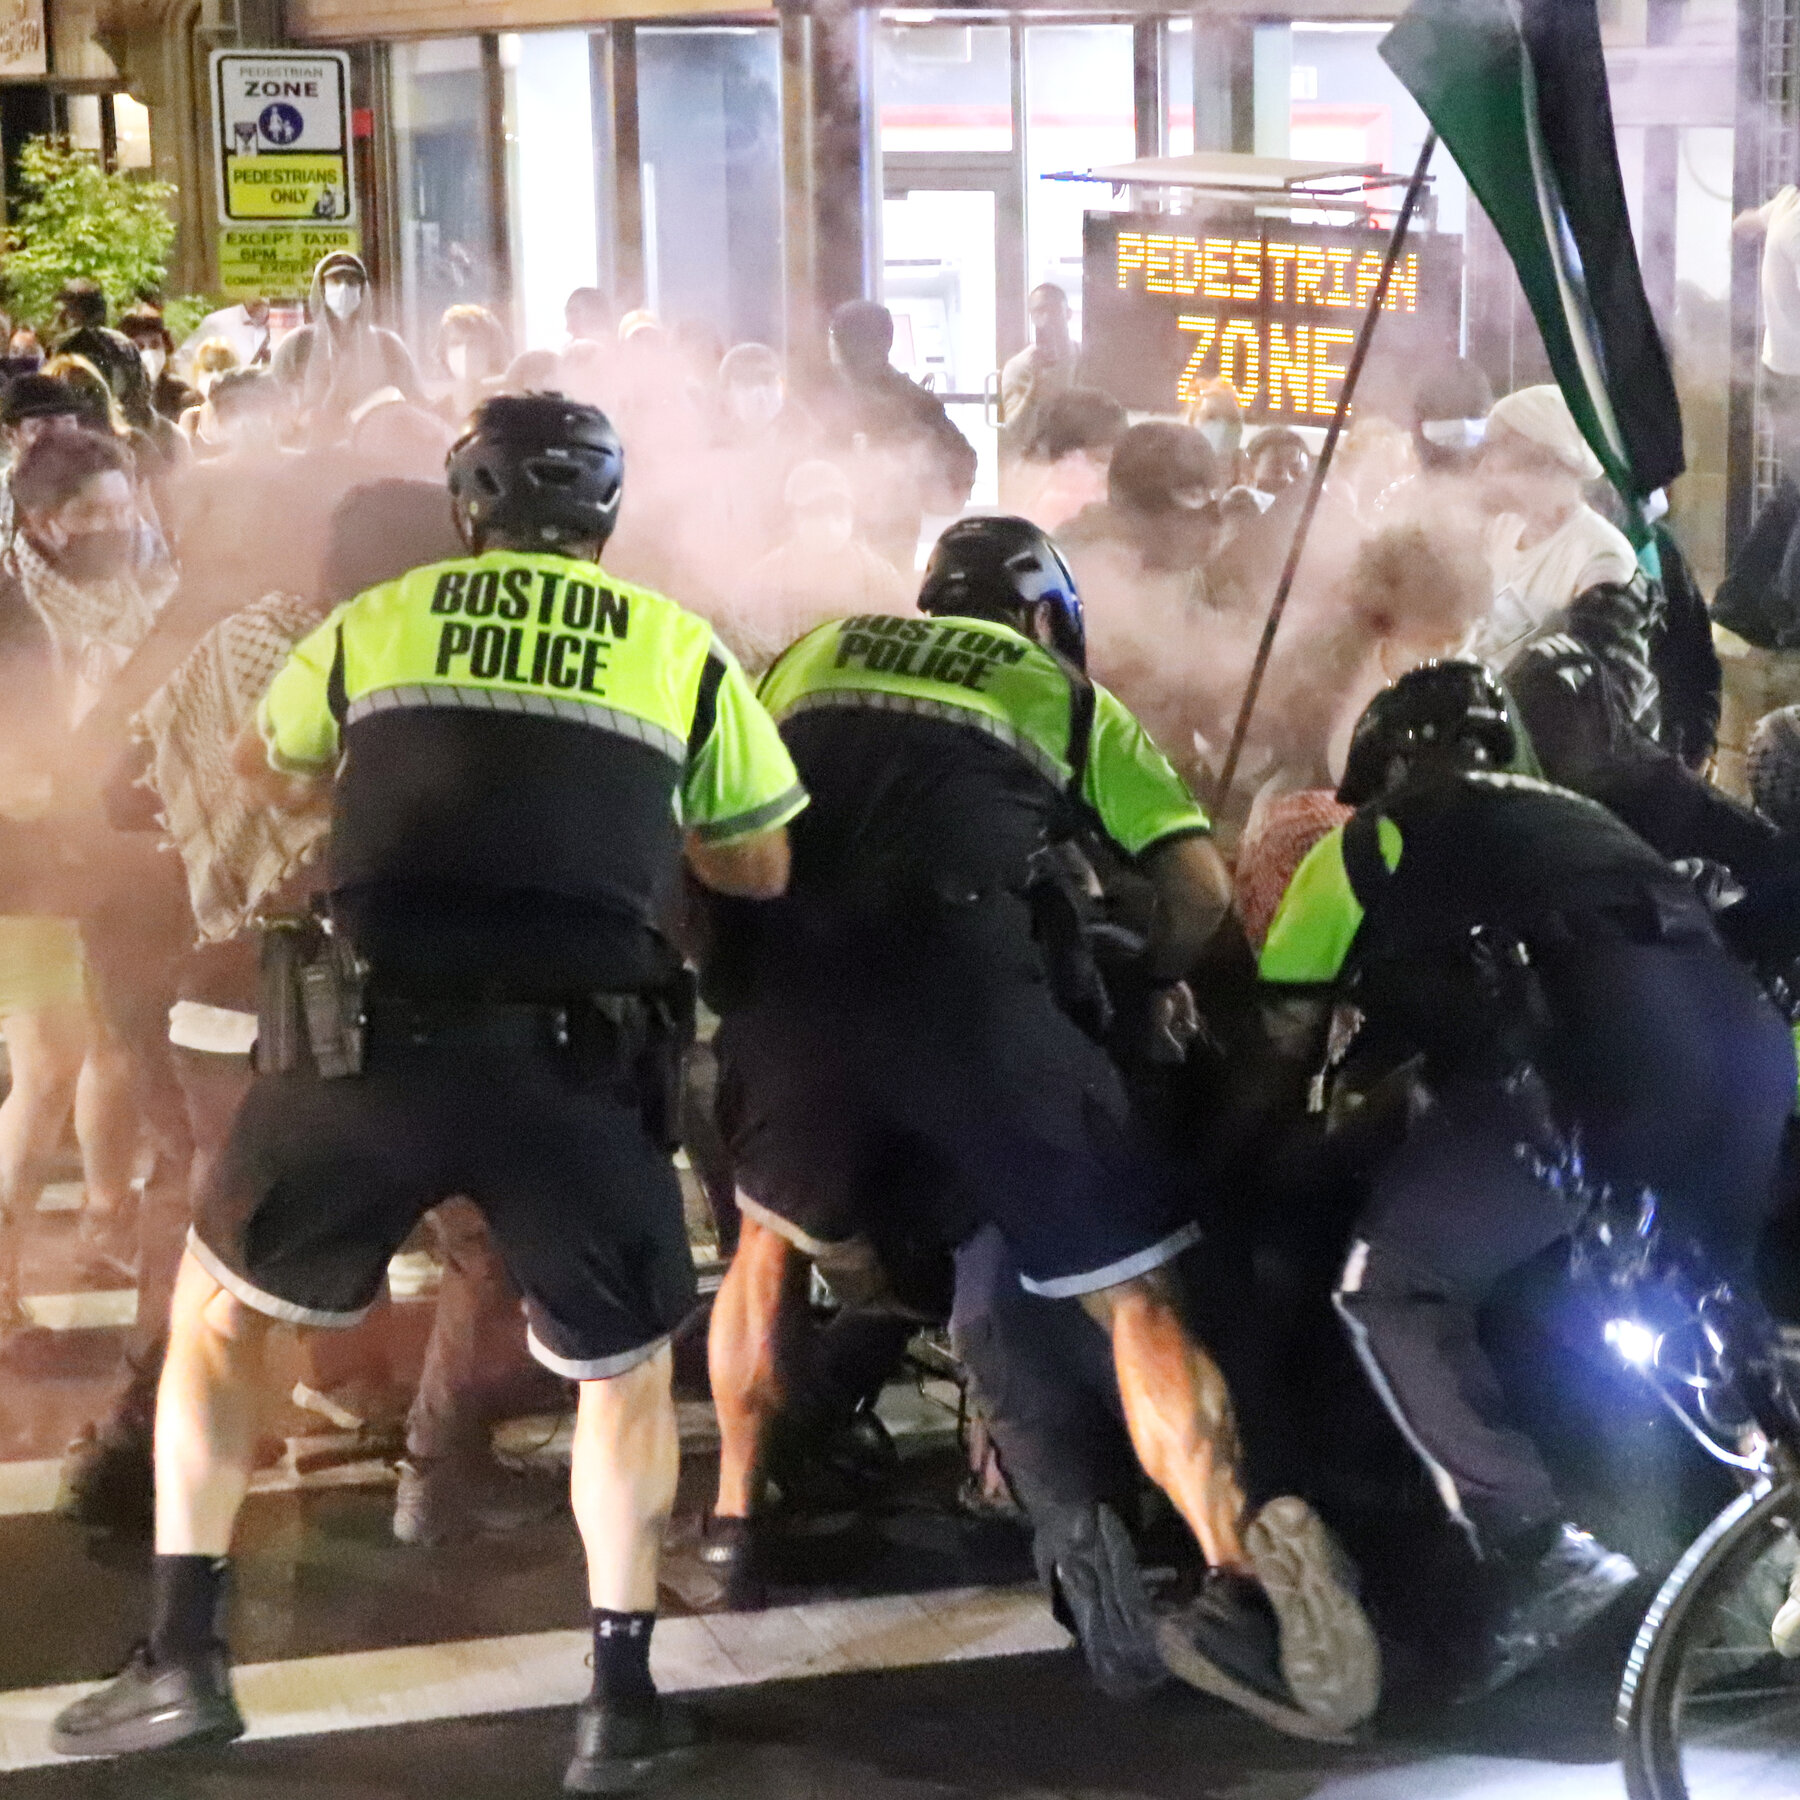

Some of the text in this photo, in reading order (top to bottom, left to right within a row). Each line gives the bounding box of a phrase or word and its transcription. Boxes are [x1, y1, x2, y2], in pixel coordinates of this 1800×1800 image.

[240, 66, 323, 78] PEDESTRIAN
[244, 81, 319, 97] ZONE
[233, 169, 337, 184] PEDESTRIANS
[271, 188, 308, 203] ONLY
[226, 232, 350, 245] EXCEPT TAXIS
[1118, 232, 1417, 312] PEDESTRIAN
[1178, 315, 1354, 416] ZONE
[430, 568, 629, 639] BOSTON
[435, 621, 611, 696] POLICE
[834, 632, 992, 693] POLICE
[838, 614, 1027, 665] BOSTON
